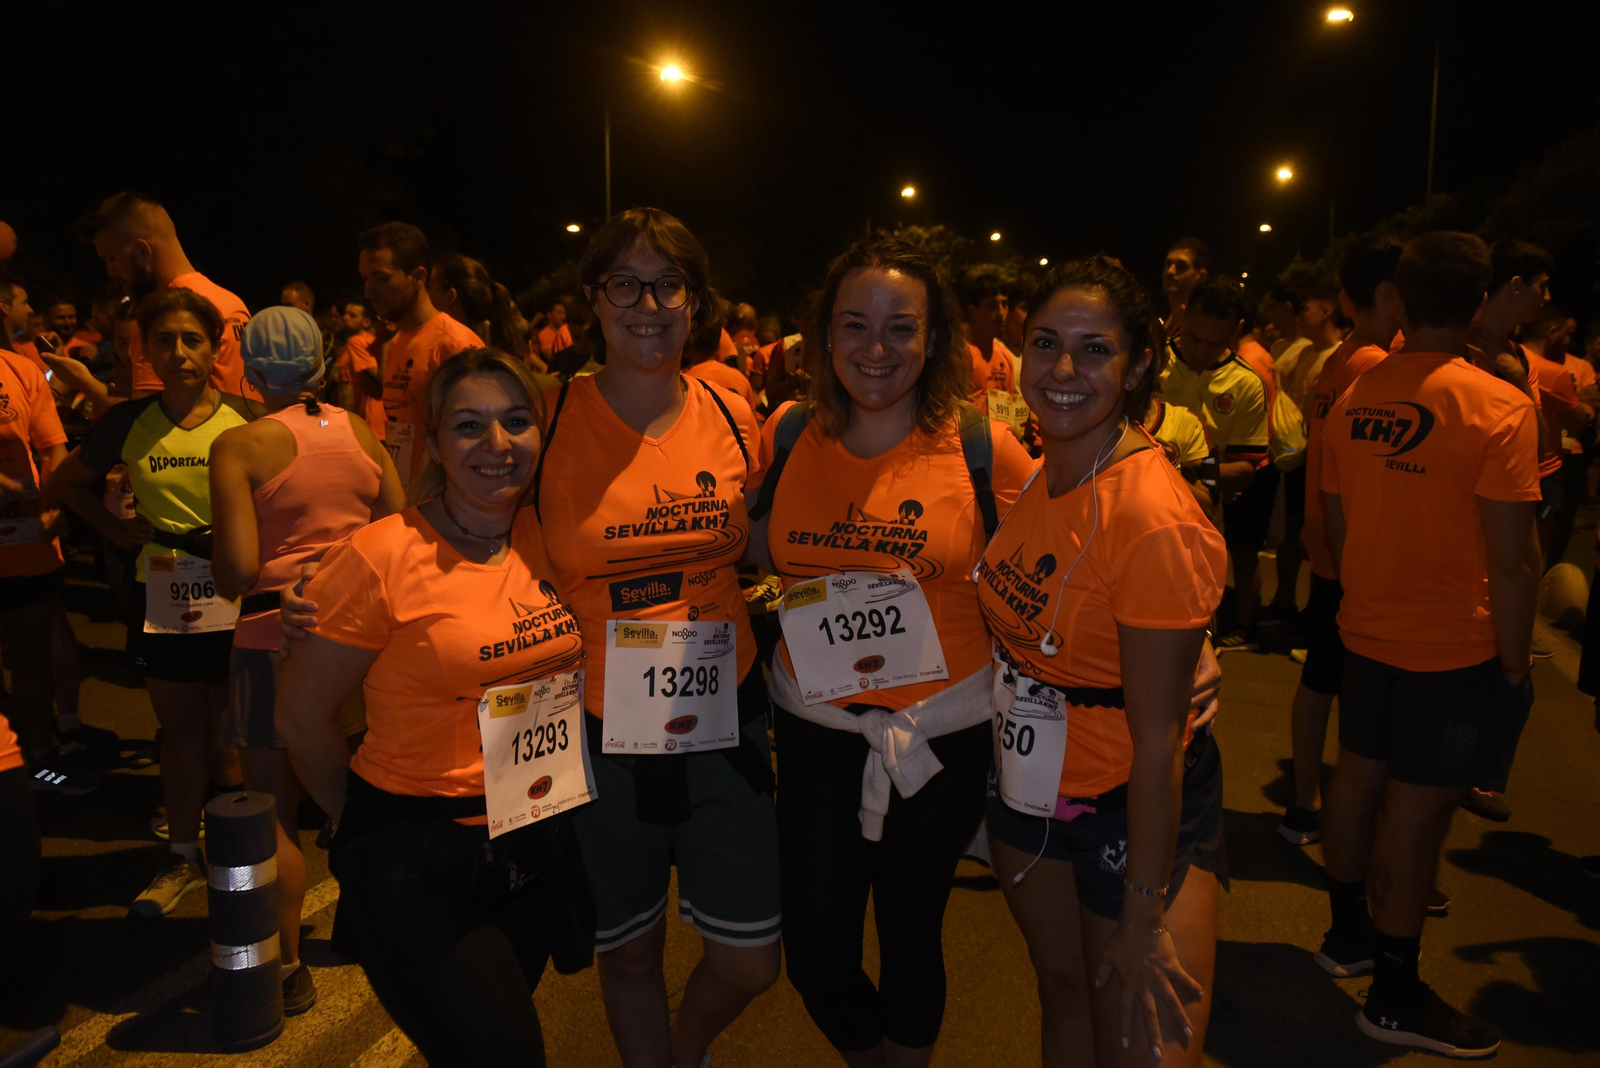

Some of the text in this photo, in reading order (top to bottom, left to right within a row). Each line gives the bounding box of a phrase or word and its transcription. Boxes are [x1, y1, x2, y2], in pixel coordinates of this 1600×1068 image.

[1345, 407, 1396, 418] NOCTURNA
[1385, 459, 1426, 474] SEVILLA
[645, 499, 730, 519] NOCTURNA
[603, 518, 687, 540] SEVILLA
[829, 521, 928, 543] NOCTURNA
[786, 530, 871, 553] SEVILLA
[979, 556, 1009, 601] EVILLA
[995, 559, 1050, 606] NOCTURNA
[170, 581, 215, 601] 9206
[818, 605, 906, 646] 13292
[478, 627, 553, 662] SEVILLA
[643, 665, 719, 698] 13298
[511, 719, 569, 766] 13293
